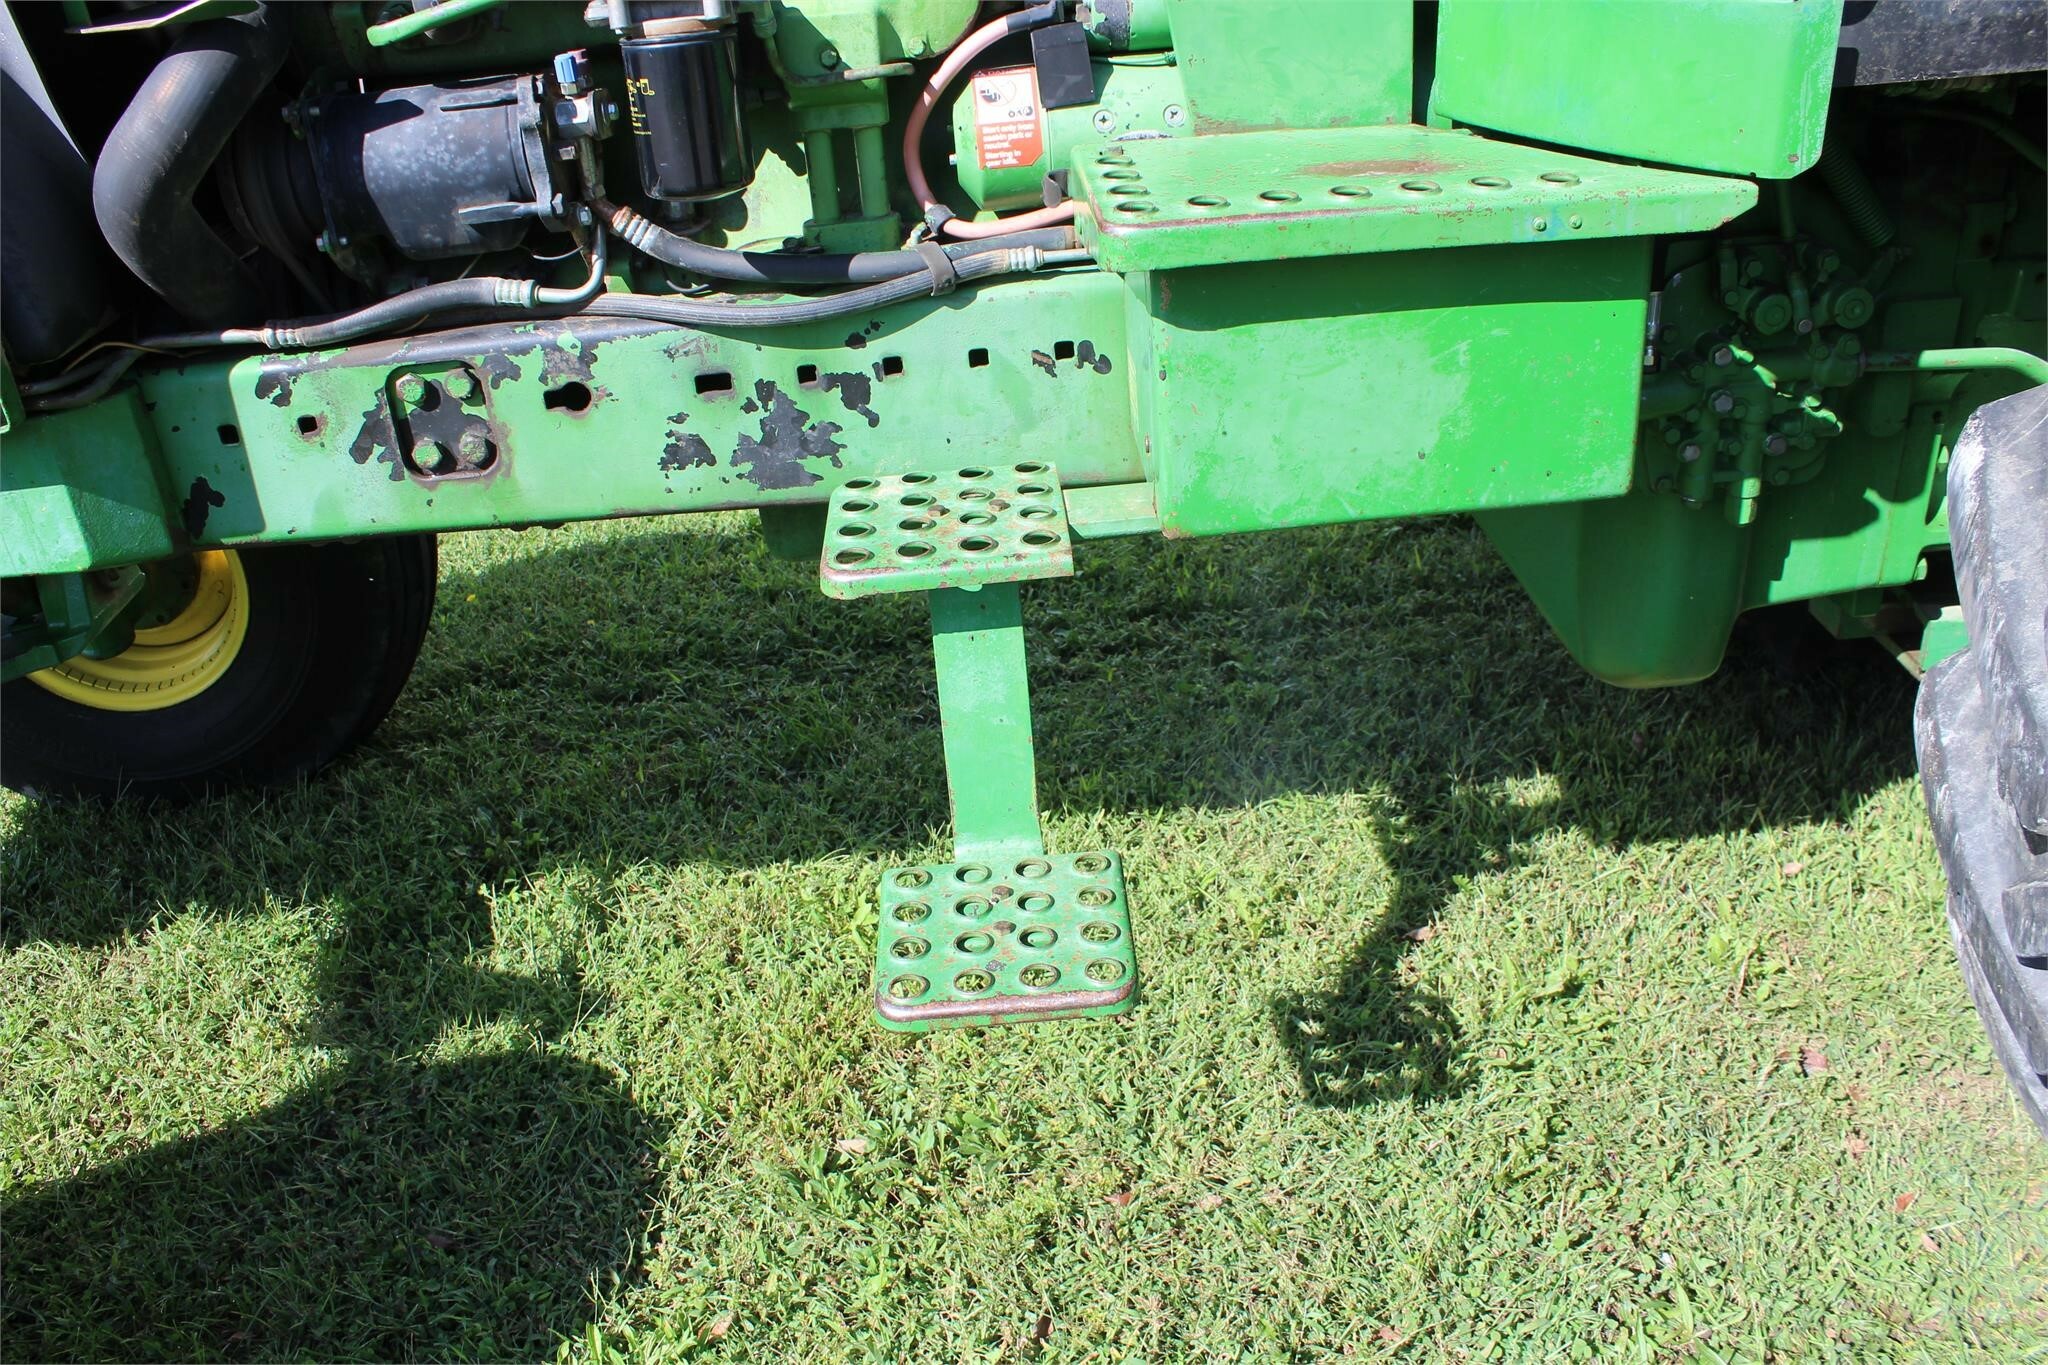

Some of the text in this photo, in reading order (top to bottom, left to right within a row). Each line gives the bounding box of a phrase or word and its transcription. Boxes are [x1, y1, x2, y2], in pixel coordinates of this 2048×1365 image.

[983, 126, 1000, 134] Start
[1001, 125, 1017, 133] only
[1008, 132, 1024, 141] park
[985, 152, 1014, 161] Starting
